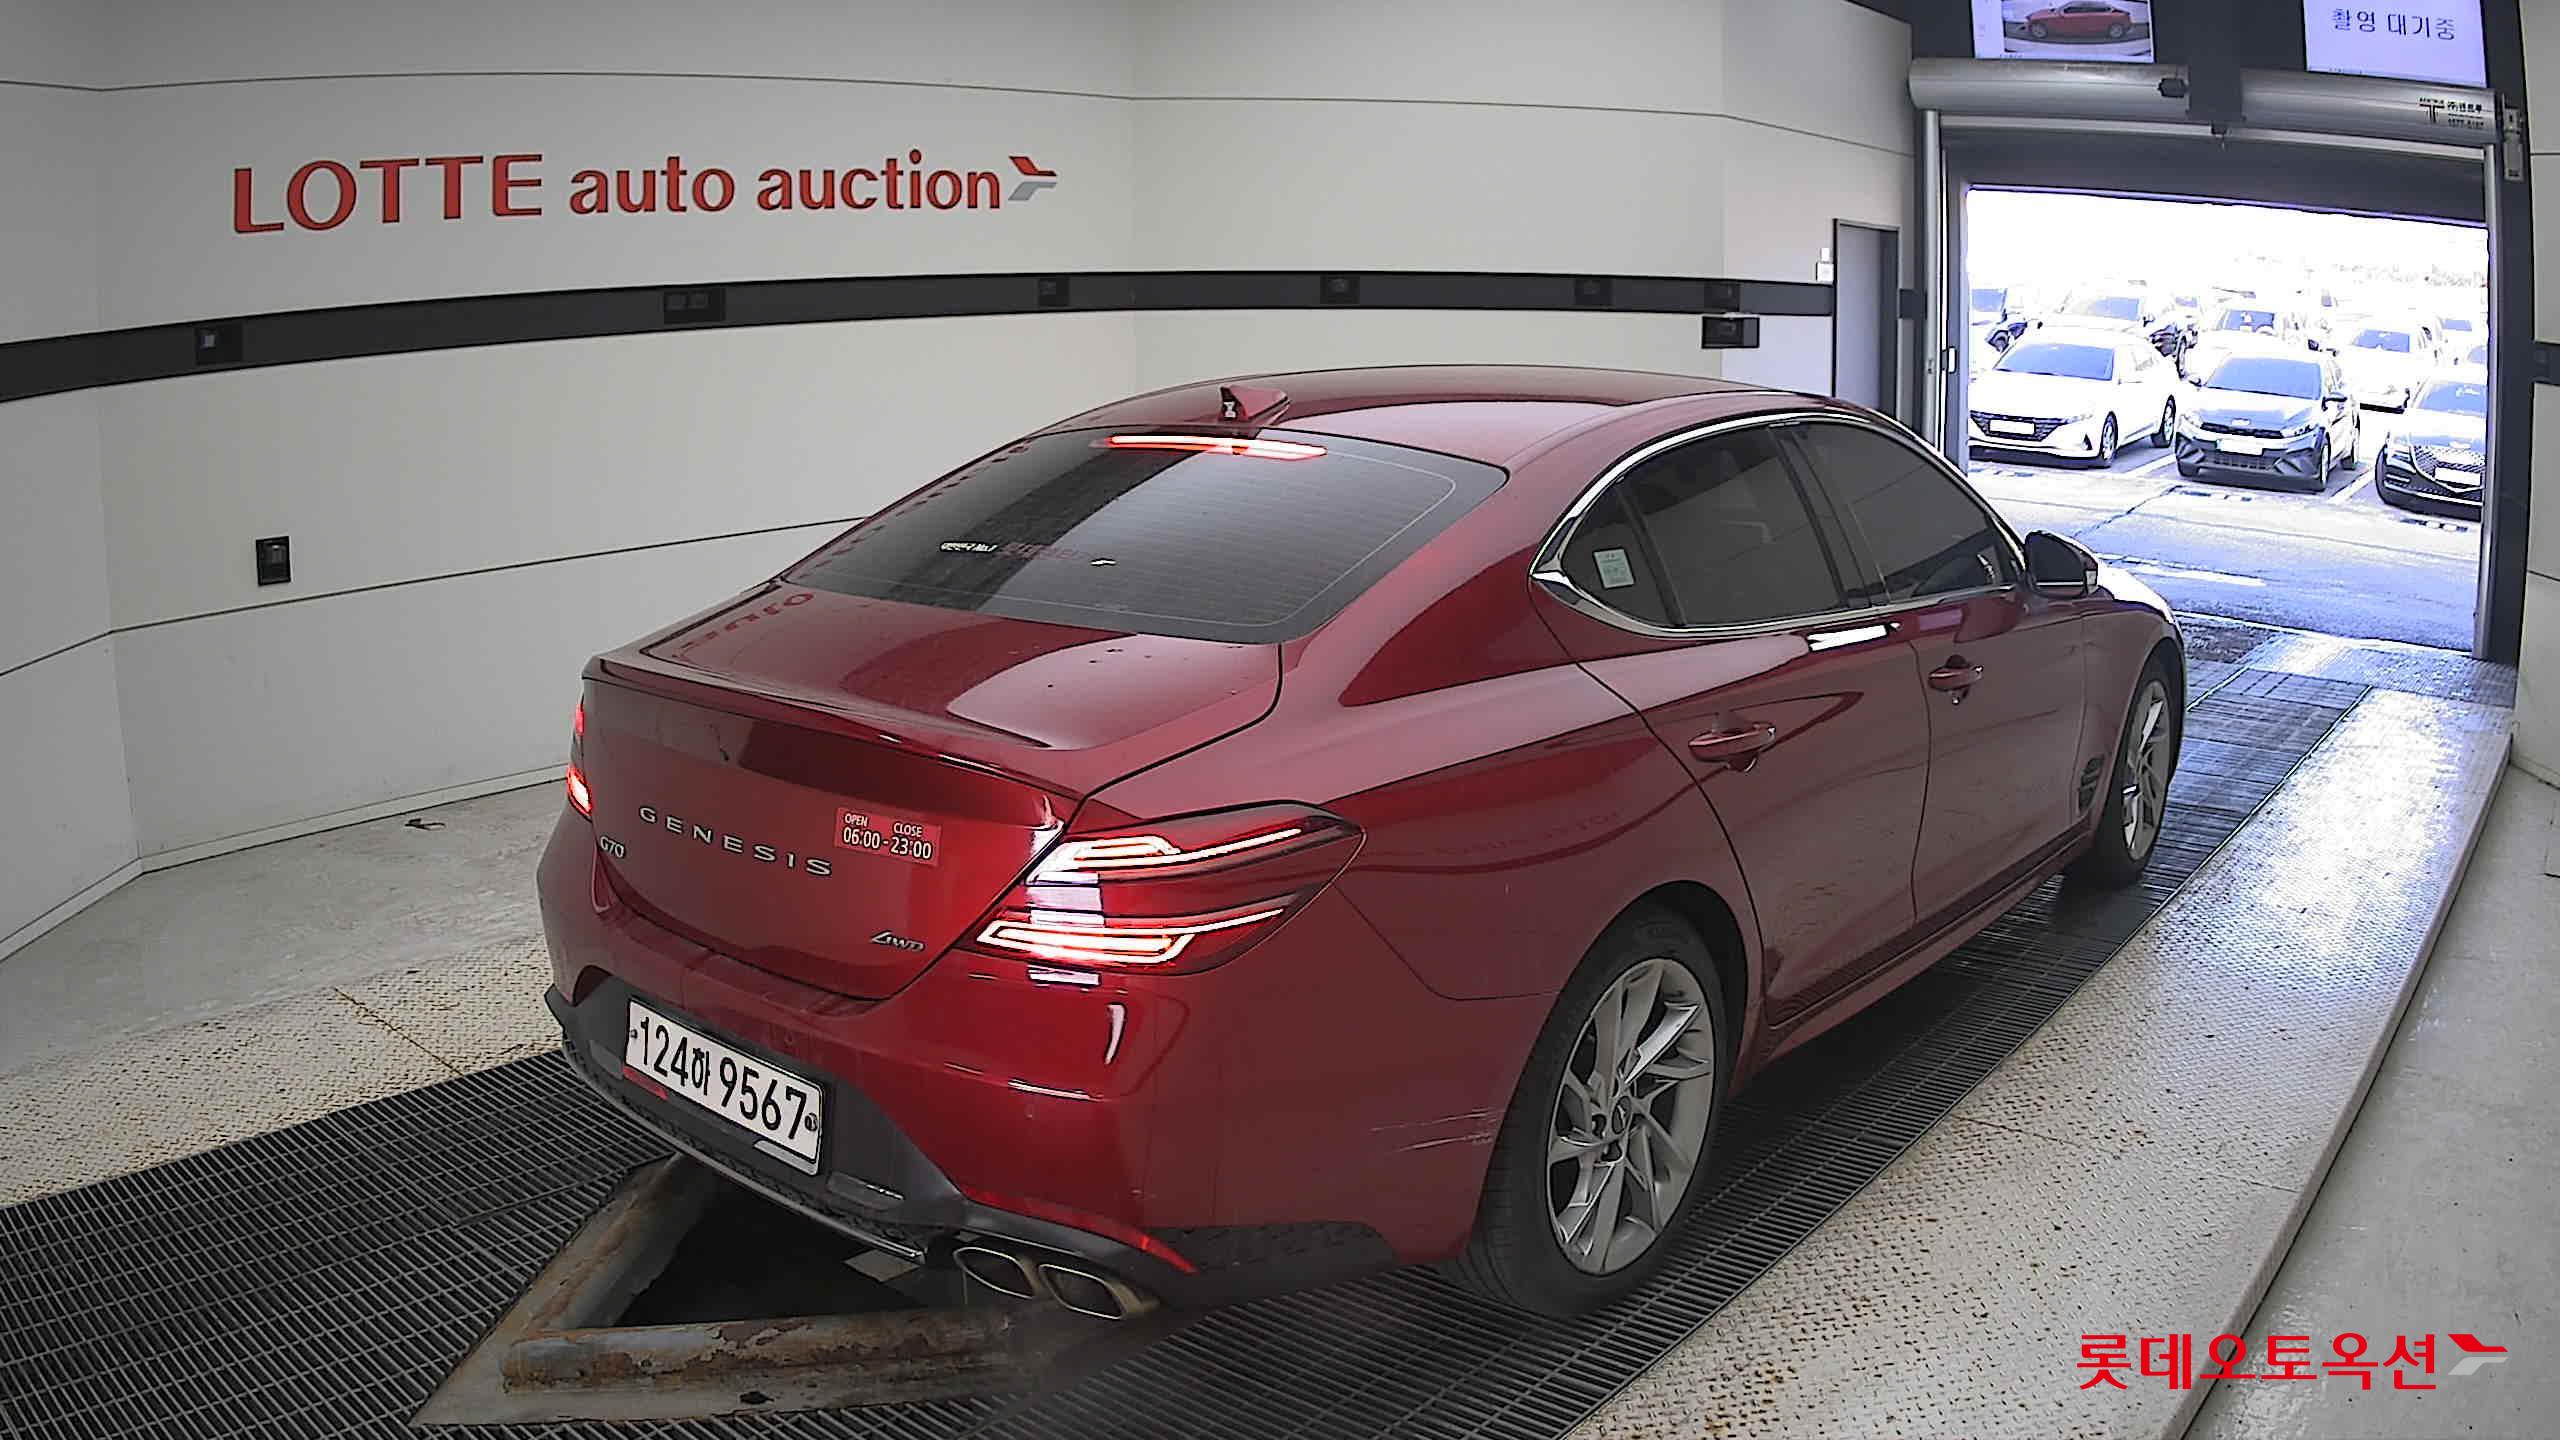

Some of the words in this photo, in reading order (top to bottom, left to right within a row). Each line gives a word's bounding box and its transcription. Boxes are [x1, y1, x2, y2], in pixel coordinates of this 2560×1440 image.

[2387, 13, 2455, 41] 대기중
[234, 153, 543, 234] LOTTE
[569, 155, 735, 214] auto
[757, 149, 1001, 210] auction
[600, 836, 625, 858] G70
[639, 806, 832, 876] GENESIS
[844, 813, 868, 827] OPEN
[893, 822, 923, 838] CLOSE
[640, 1016, 711, 1096] 124하
[719, 1057, 807, 1140] 9567
